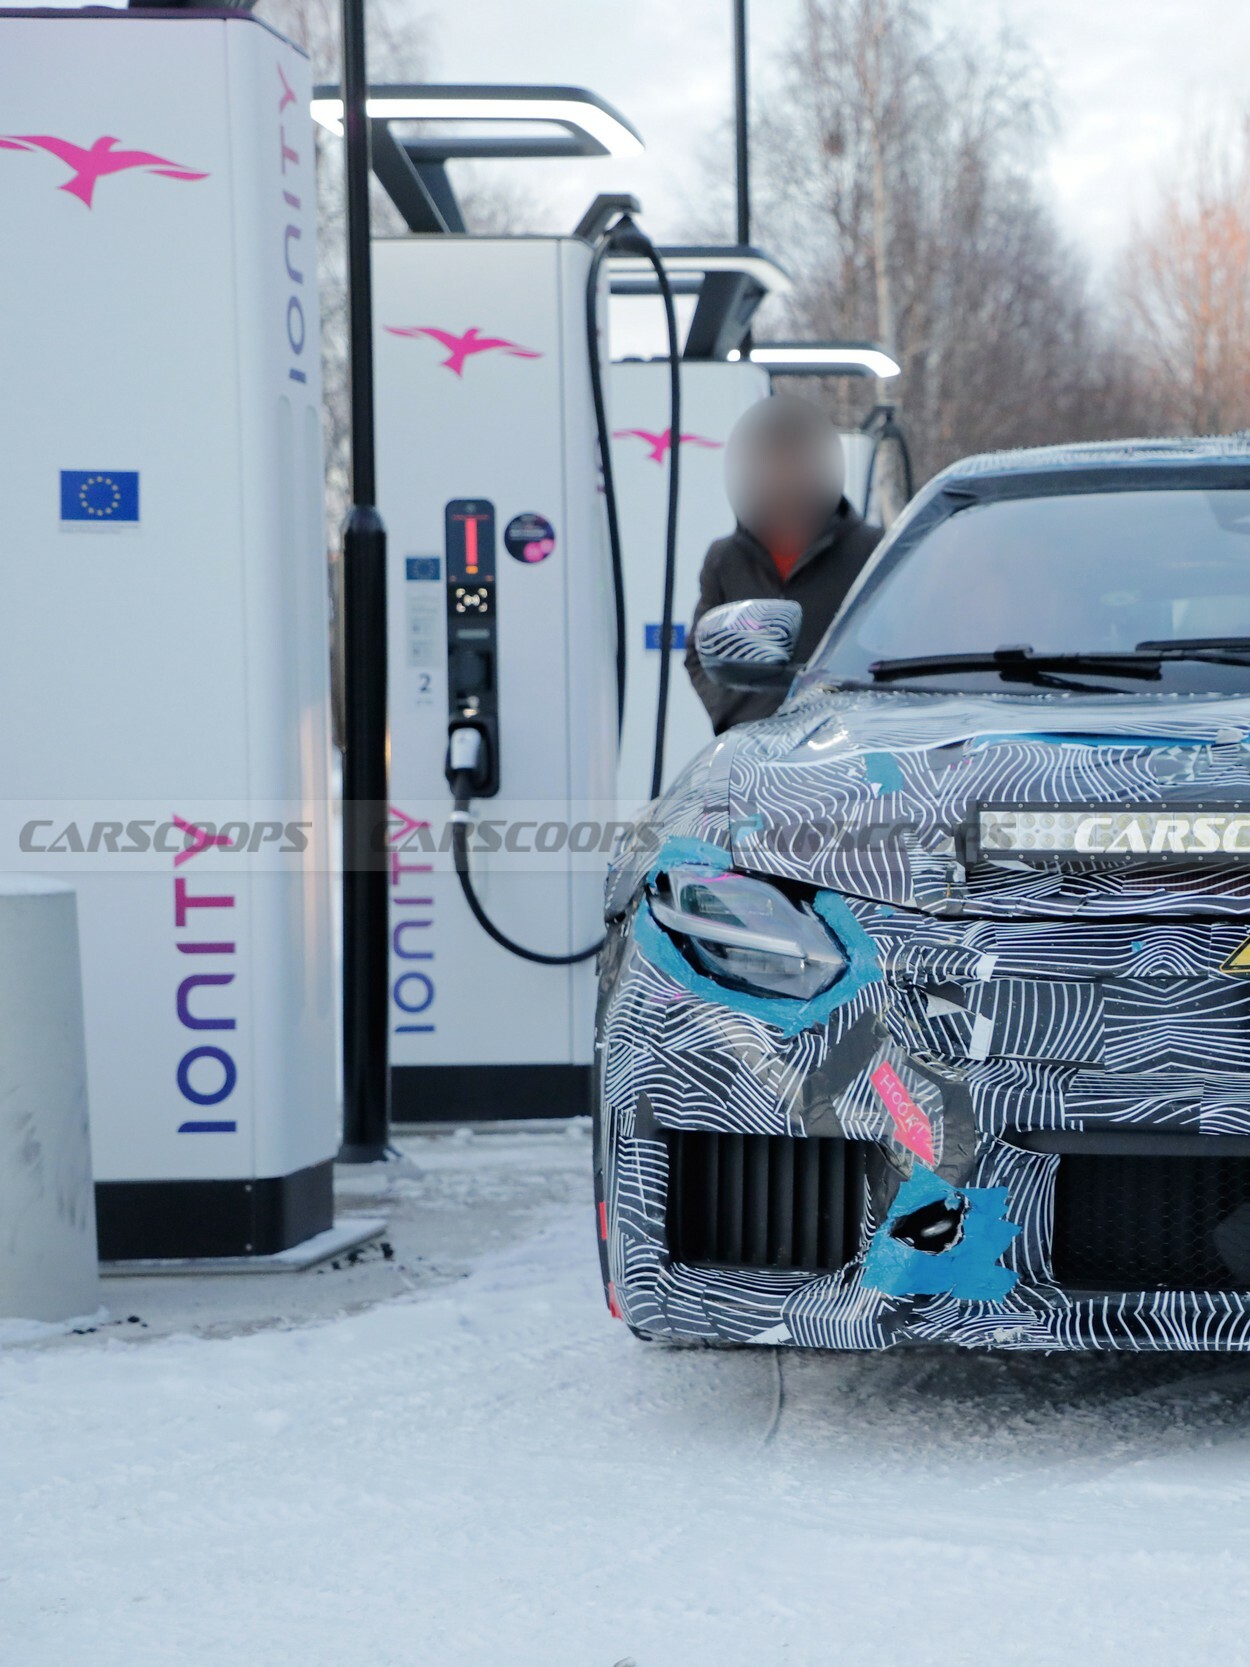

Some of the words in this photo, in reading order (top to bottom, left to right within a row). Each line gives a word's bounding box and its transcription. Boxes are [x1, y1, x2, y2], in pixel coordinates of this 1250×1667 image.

[277, 60, 307, 385] IONITY
[419, 673, 432, 693] 2
[173, 813, 237, 1133] IONITY
[388, 804, 435, 1033] IONITY
